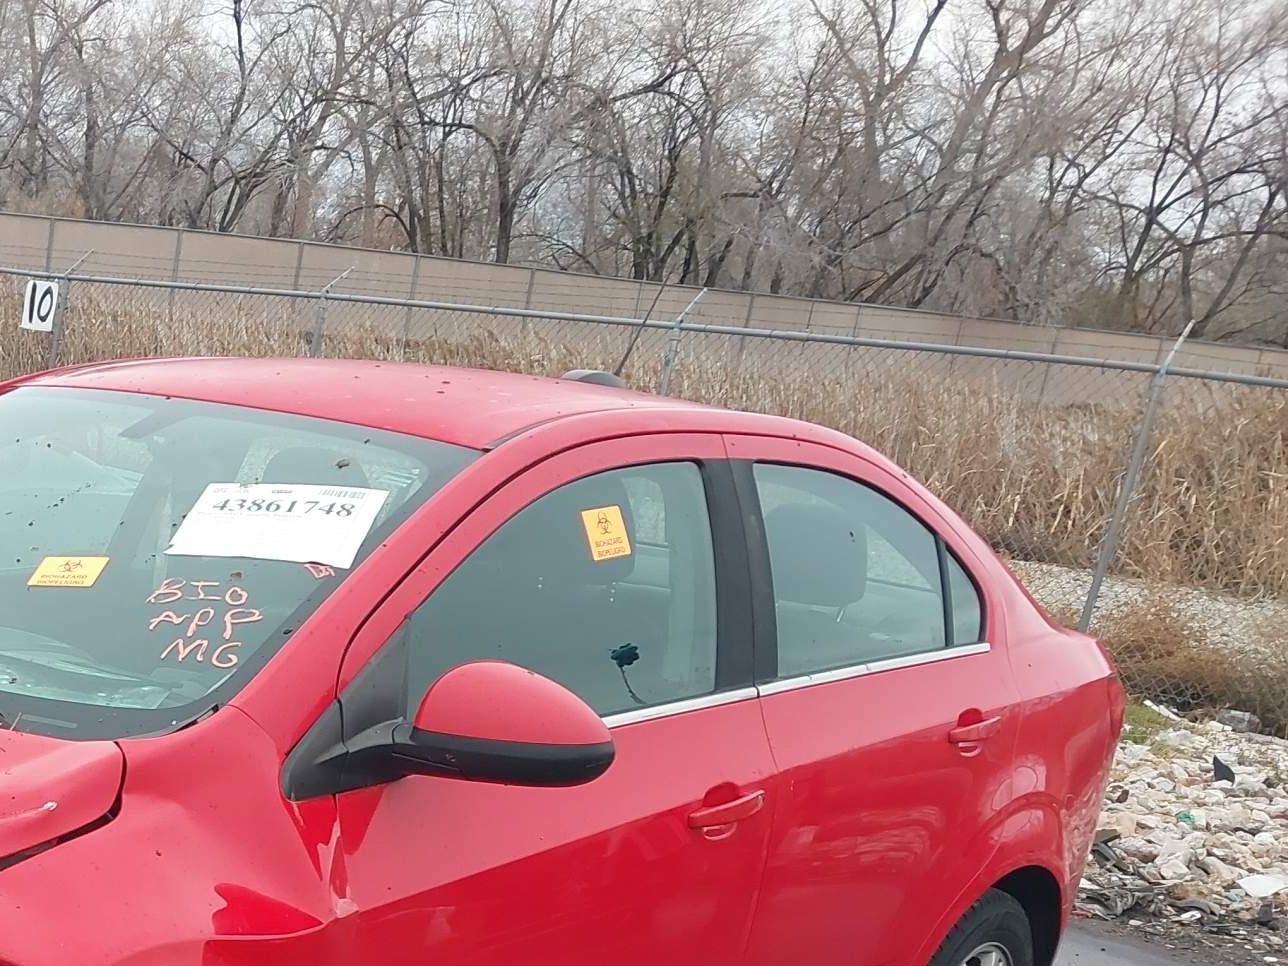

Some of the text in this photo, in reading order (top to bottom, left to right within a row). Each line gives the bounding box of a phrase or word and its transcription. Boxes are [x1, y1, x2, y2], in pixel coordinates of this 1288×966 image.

[28, 281, 54, 323] 10
[211, 497, 357, 518] 43861748
[145, 577, 249, 605] BIO
[160, 638, 242, 668] MG
